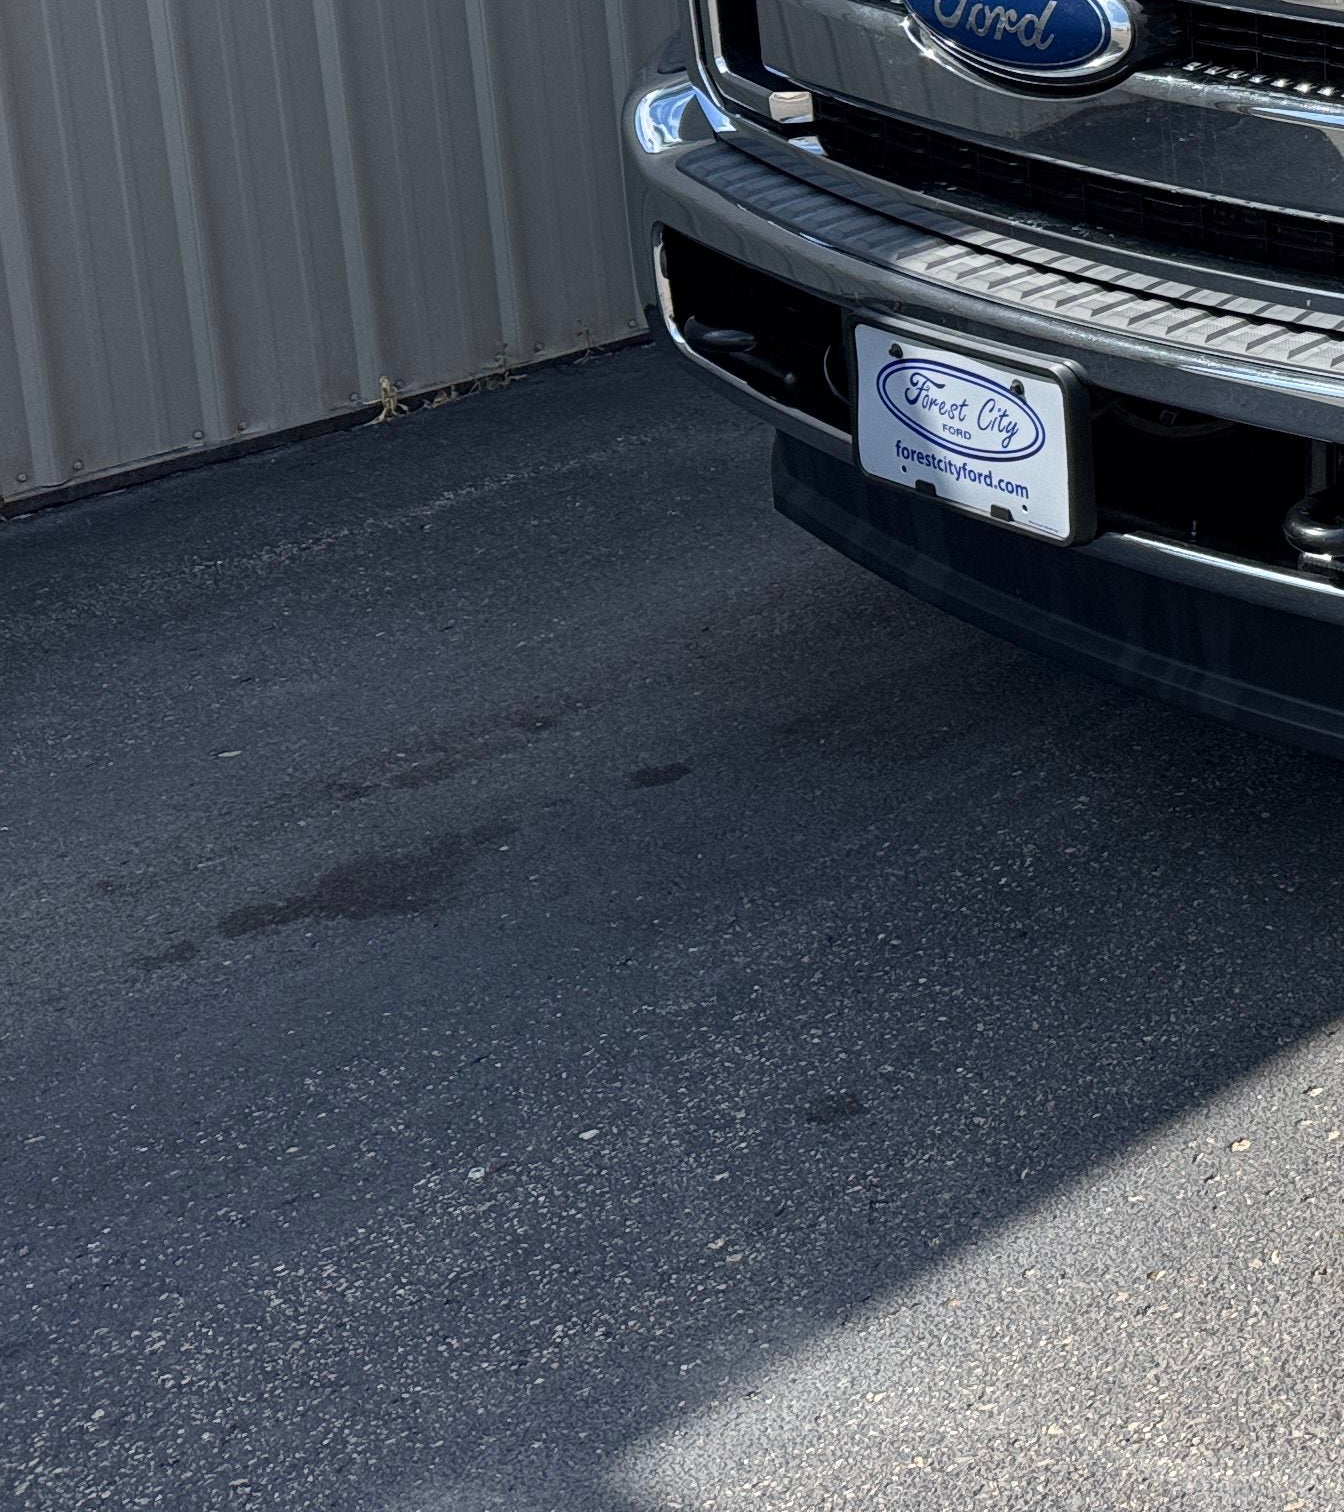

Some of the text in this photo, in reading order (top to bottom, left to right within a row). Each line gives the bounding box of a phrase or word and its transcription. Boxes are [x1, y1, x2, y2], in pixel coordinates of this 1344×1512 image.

[905, 372, 1020, 449] Forest City
[942, 422, 972, 441] FORD
[895, 440, 1029, 500] forestcityford.com
